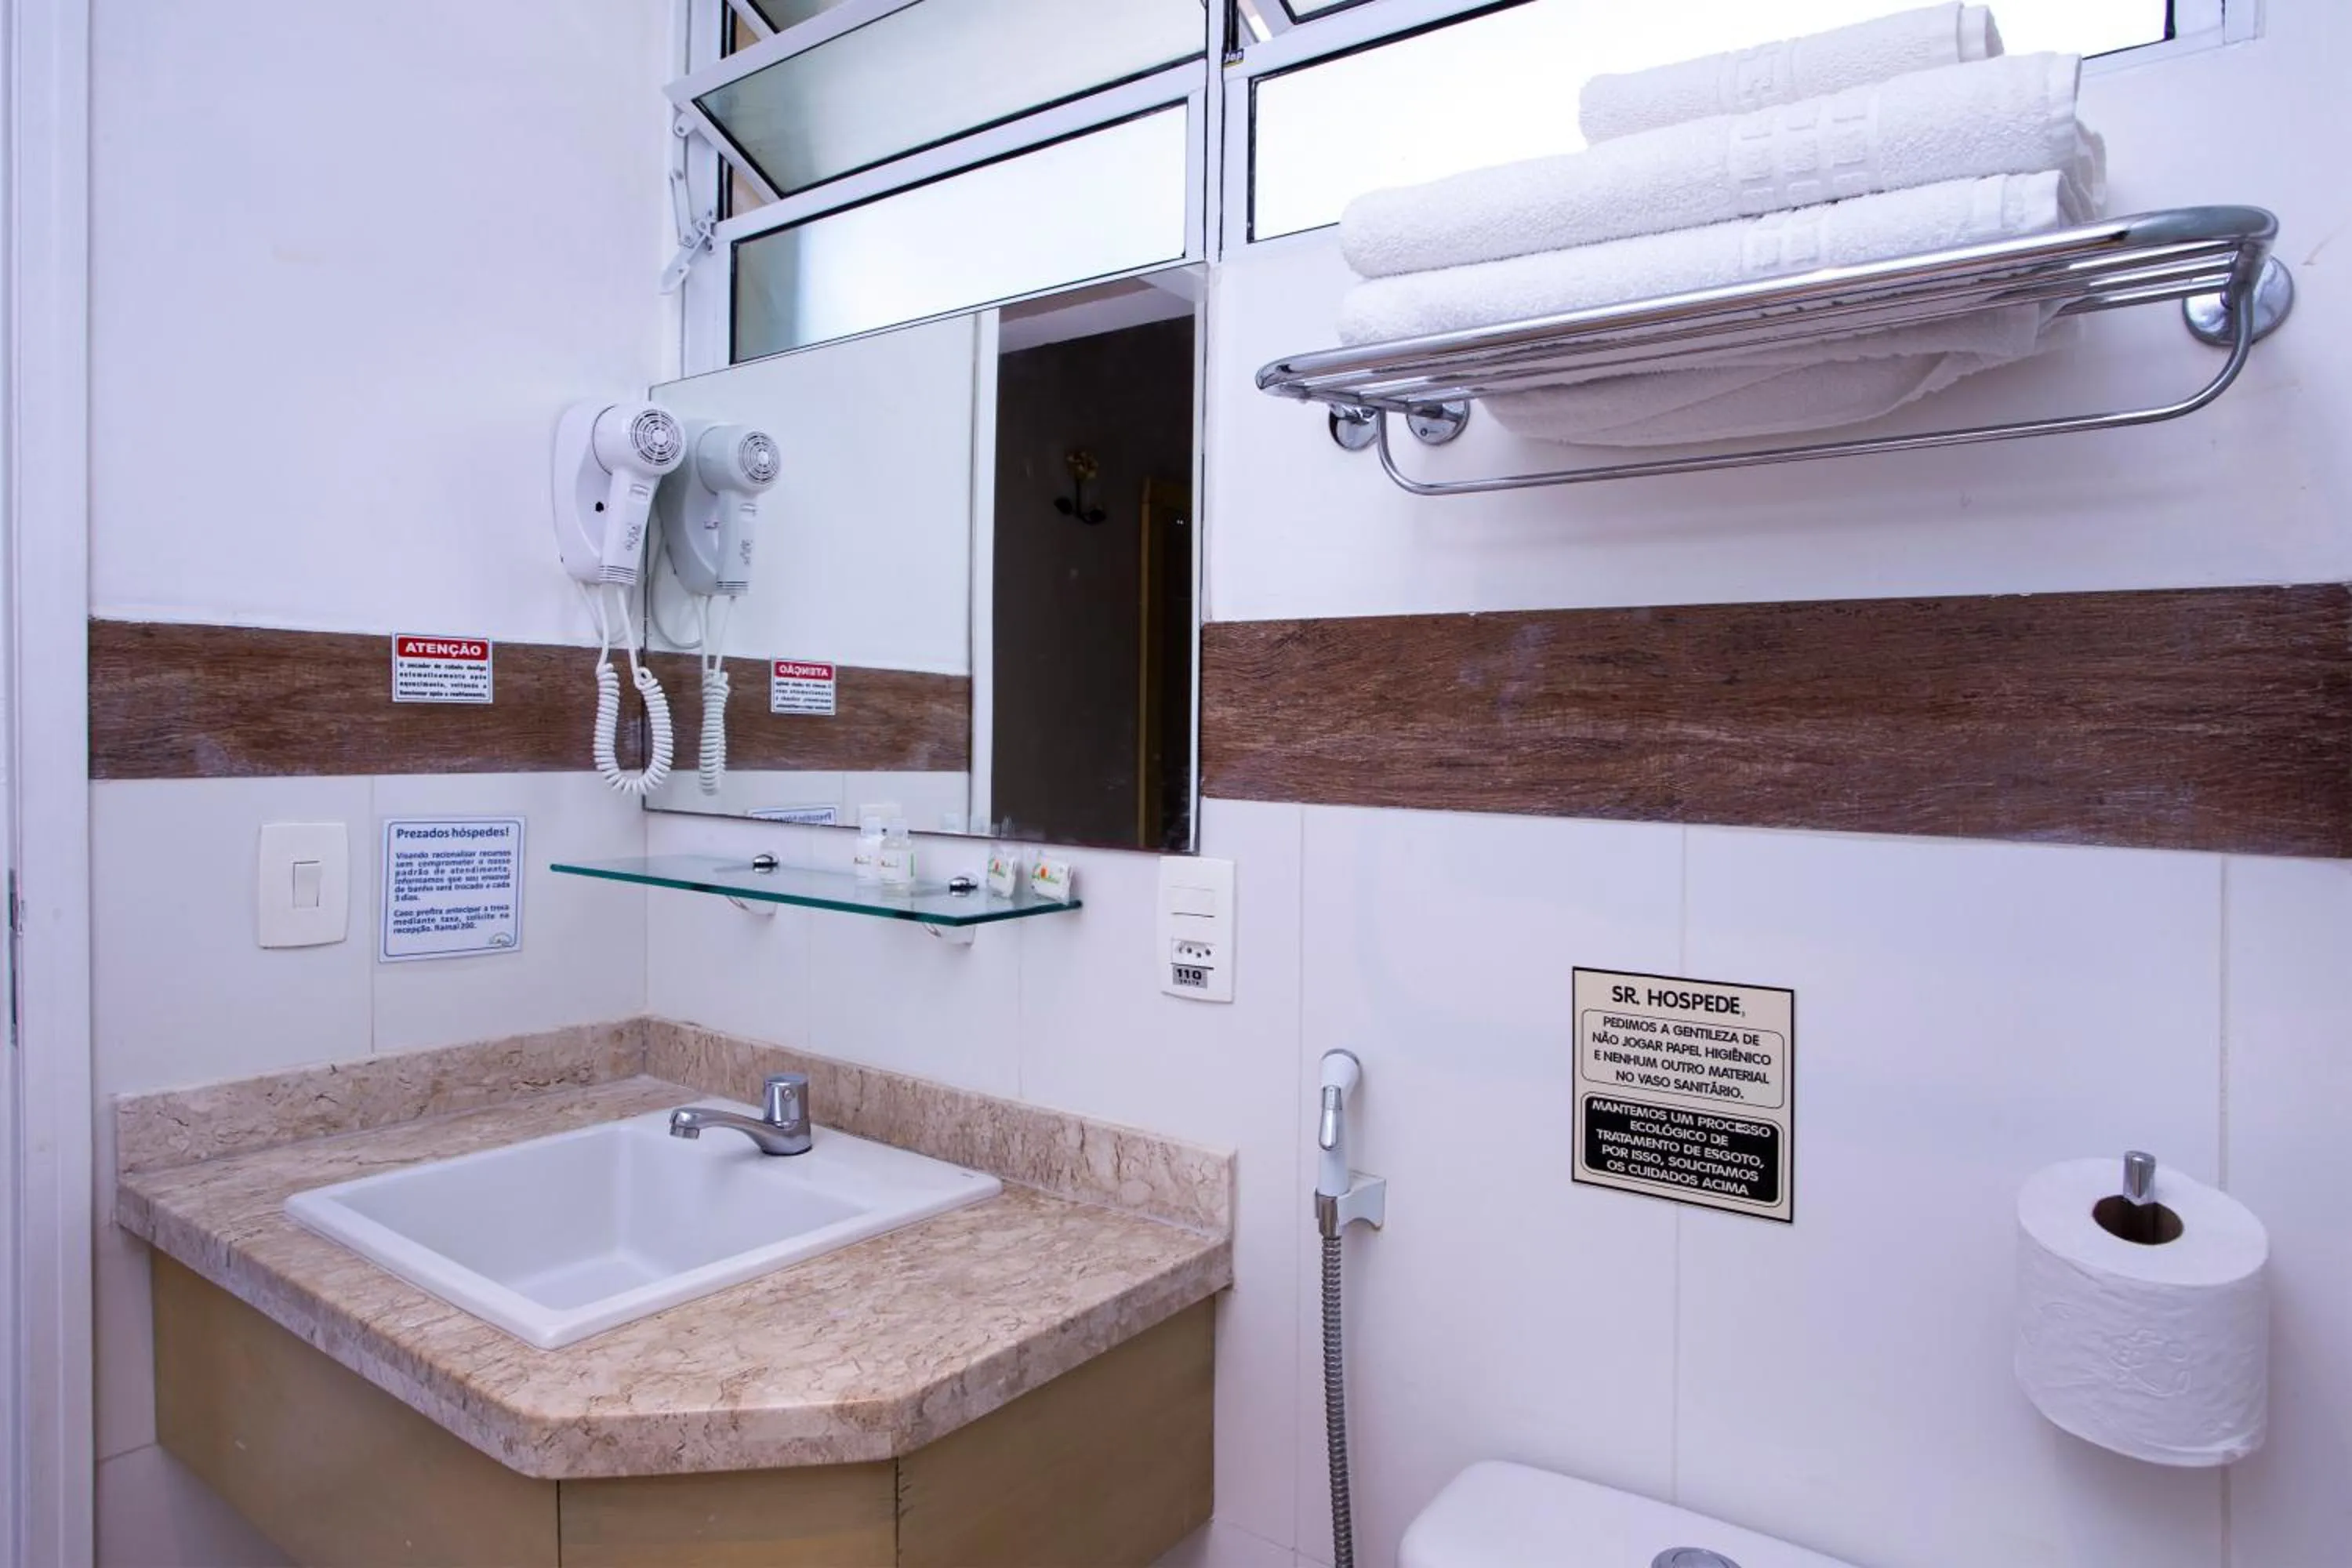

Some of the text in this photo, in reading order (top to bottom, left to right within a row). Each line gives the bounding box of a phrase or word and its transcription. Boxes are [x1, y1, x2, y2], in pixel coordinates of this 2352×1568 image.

[405, 641, 481, 657] ATENÇÃO
[396, 827, 509, 840] Prezados hóspedes!
[1177, 968, 1202, 980] 110
[1611, 985, 1640, 1005] SR.
[1603, 1016, 1760, 1046] PEDIMOS A GENTILEZA DE
[1592, 1030, 1772, 1065] NÃO JOGAR PAPEL HIGIÊNICO
[1594, 1049, 1769, 1084] E NENHUM OUTRO MATERIAL
[1616, 1069, 1744, 1099] NO VASO SANITÁRIO.
[1592, 1099, 1771, 1138] MANTEMOS UM PROCESSO
[1630, 1120, 1729, 1147] ECOLÓGICO DE
[1596, 1129, 1766, 1170] TRATAMENTO DE ESGOTO,
[1602, 1144, 1759, 1182] POR ISSO, SOLICITAMOS
[1606, 1160, 1750, 1196] OS CUIDADOS ACIMA
